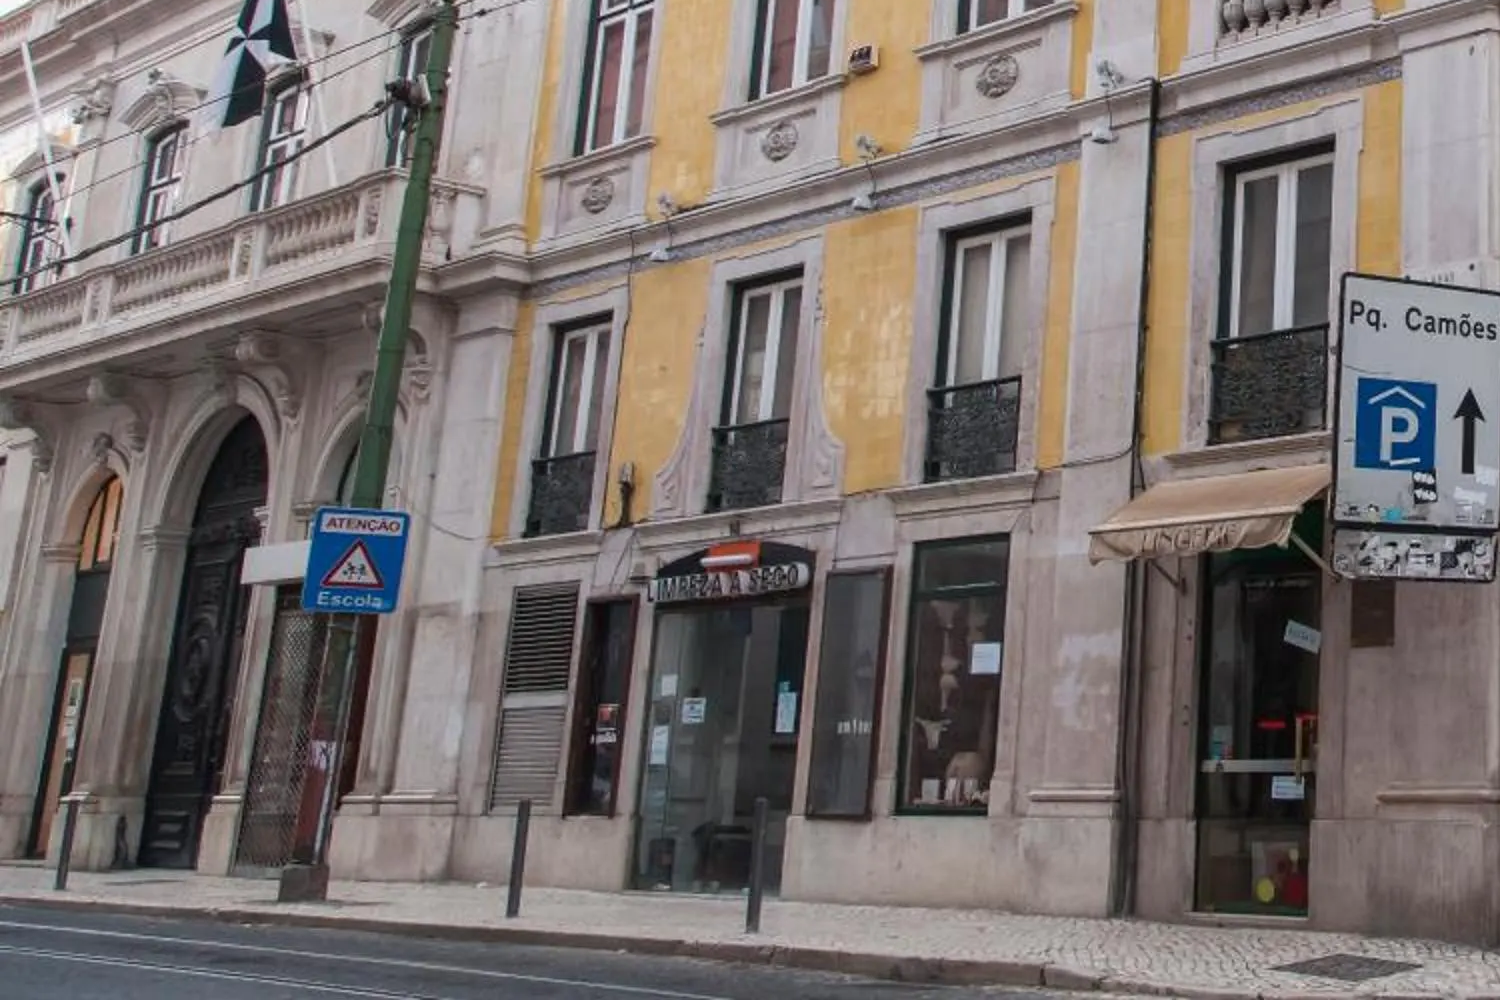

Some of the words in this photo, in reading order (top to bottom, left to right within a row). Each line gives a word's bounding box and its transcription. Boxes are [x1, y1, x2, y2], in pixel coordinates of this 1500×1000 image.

[1349, 300, 1388, 333] Pq.
[1404, 306, 1498, 341] Camões
[326, 516, 401, 533] ATENÇÃO
[317, 590, 385, 609] Escola
